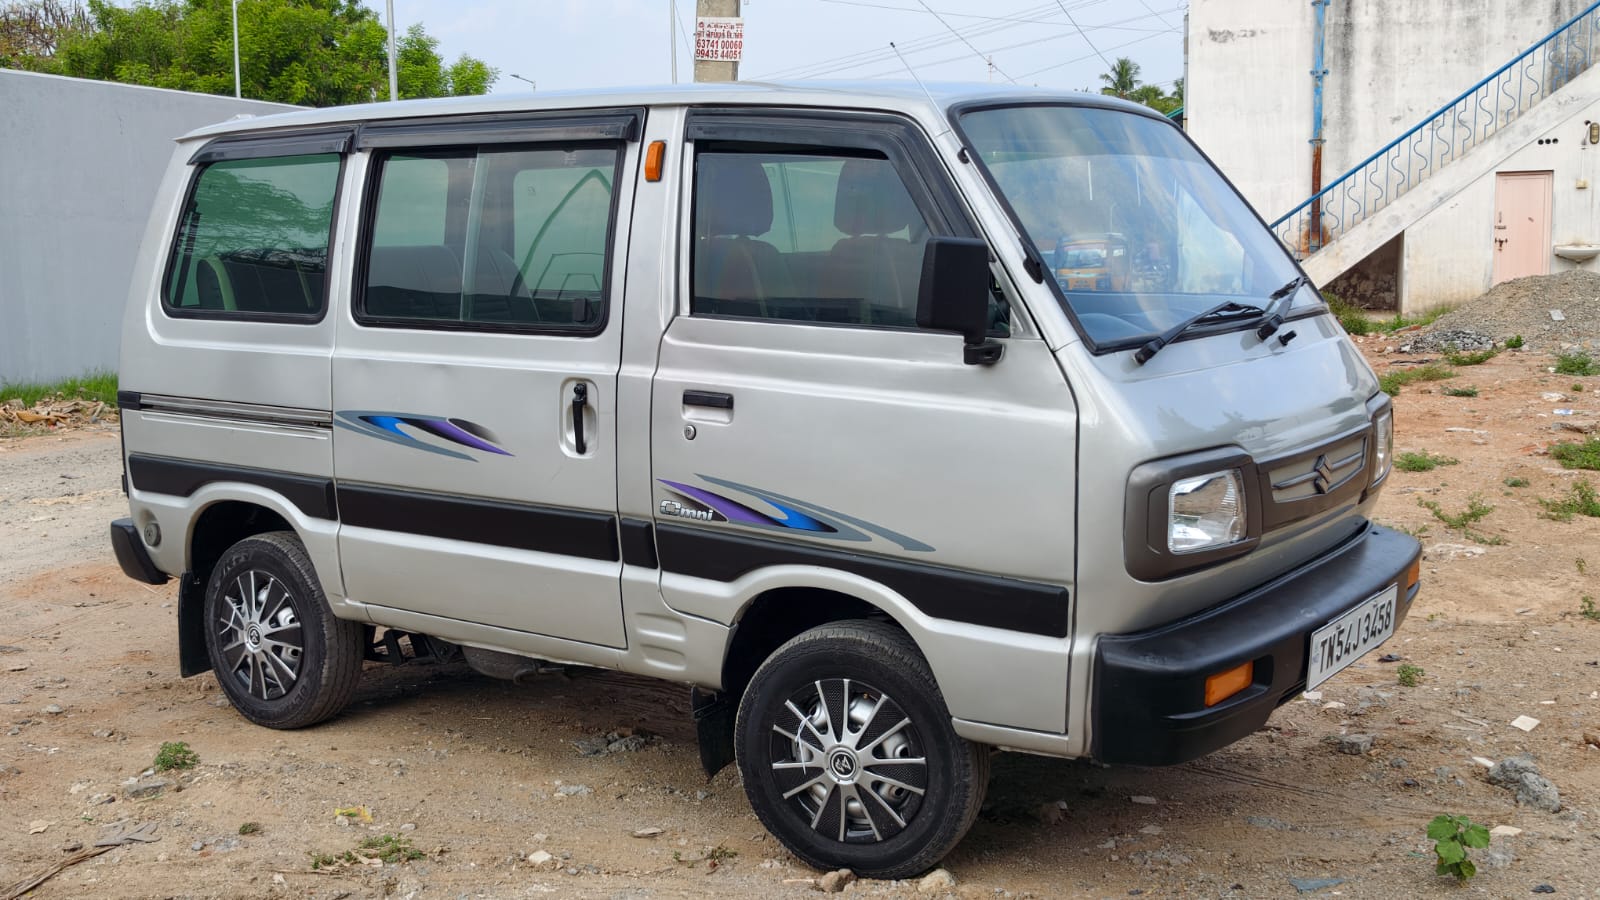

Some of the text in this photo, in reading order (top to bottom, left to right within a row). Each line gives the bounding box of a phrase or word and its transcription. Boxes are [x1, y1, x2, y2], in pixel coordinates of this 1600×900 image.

[696, 39, 743, 50] 63741 00060
[696, 49, 742, 60] 99435 44051
[660, 500, 713, 521] Omni
